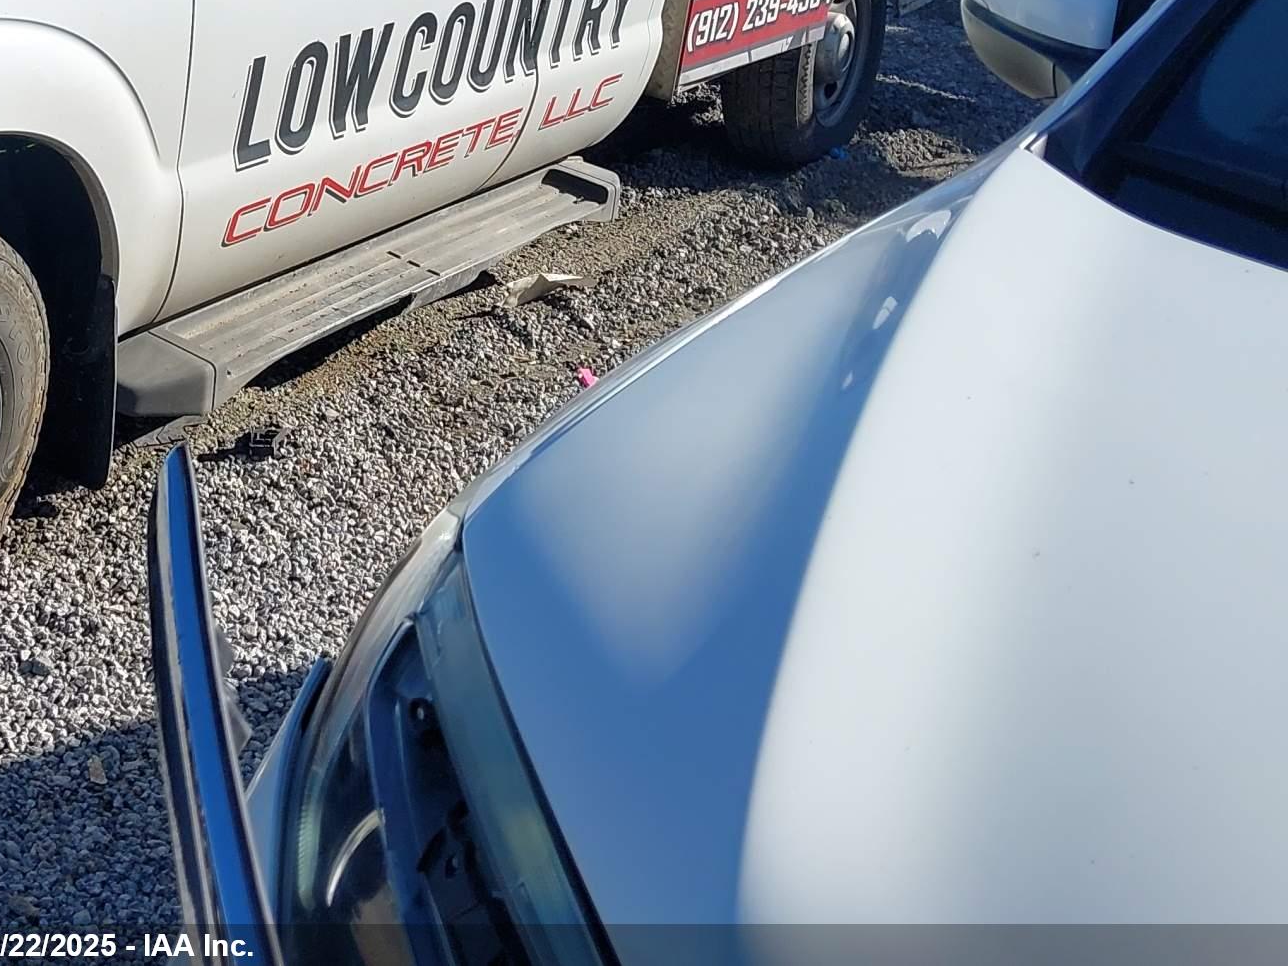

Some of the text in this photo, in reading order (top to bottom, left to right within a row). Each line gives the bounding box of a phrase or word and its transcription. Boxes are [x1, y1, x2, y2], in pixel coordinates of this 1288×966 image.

[687, 1, 740, 53] (912)
[221, 74, 625, 247] CONCRETE LLC
